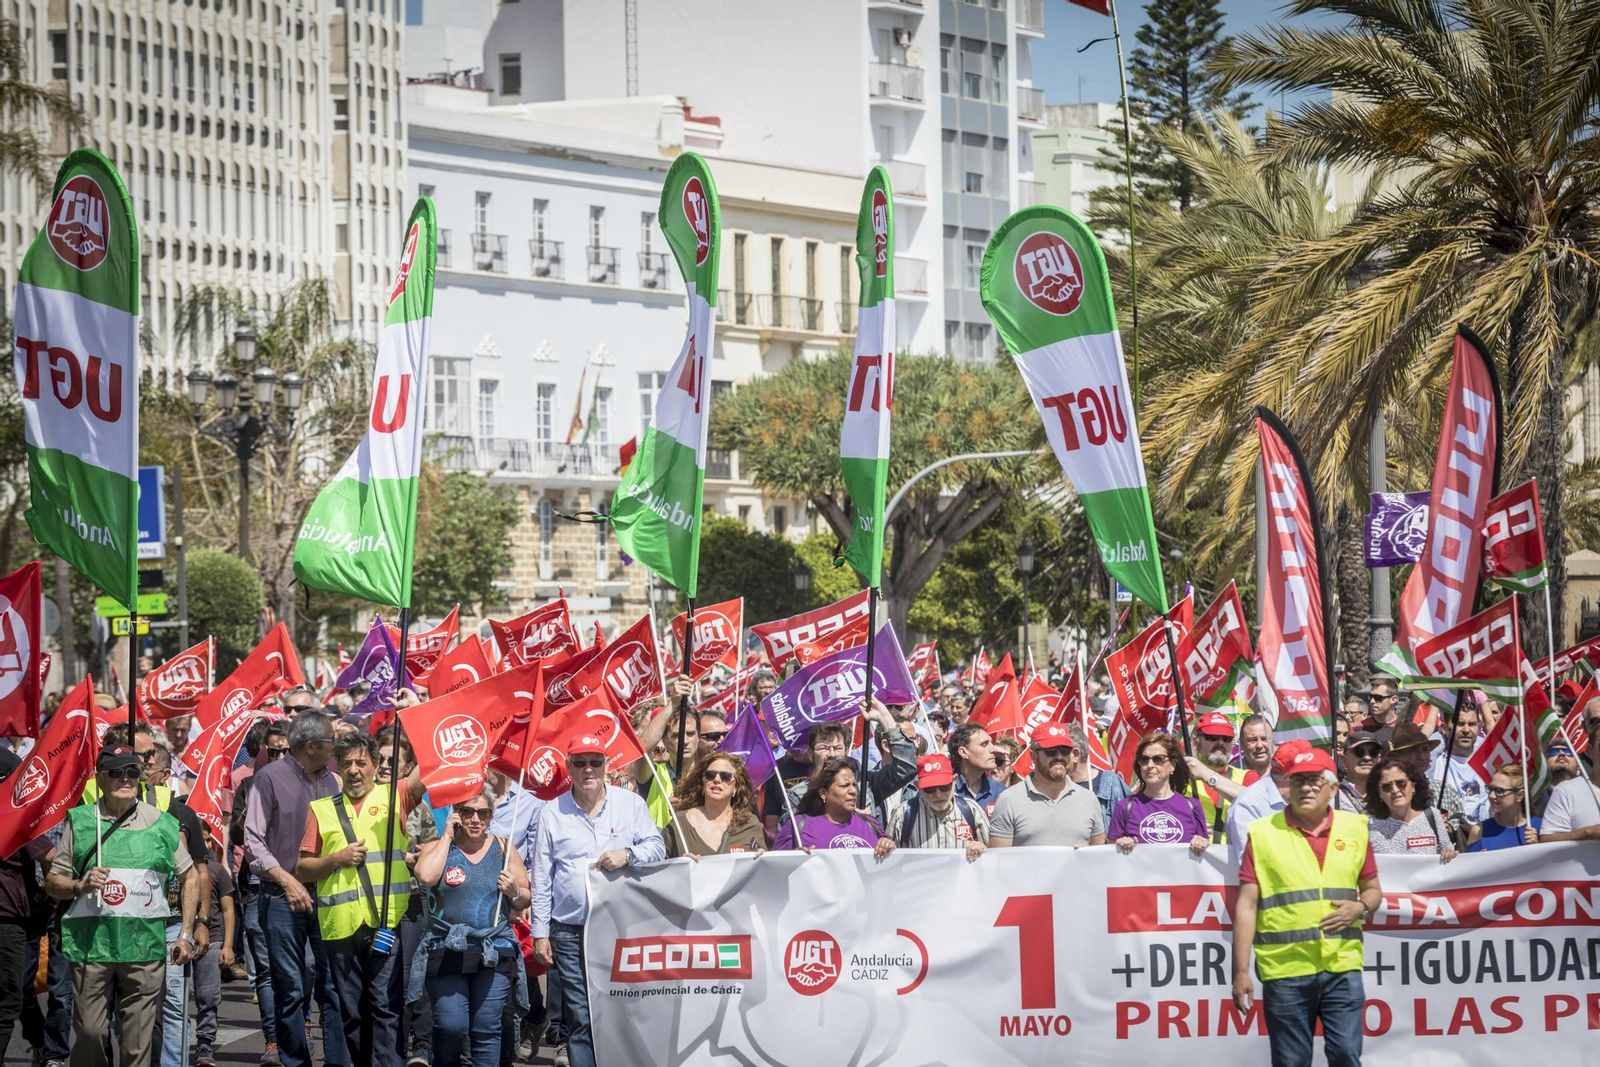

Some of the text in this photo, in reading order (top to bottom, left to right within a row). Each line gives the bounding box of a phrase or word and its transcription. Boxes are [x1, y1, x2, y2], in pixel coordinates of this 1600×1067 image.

[157, 659, 204, 691] UGT
[607, 647, 651, 701] UGT
[224, 690, 251, 716] UGT
[438, 720, 477, 750] UGT
[530, 749, 557, 784] UGT
[1142, 827, 1182, 835] FEMINISTA
[104, 884, 124, 895] UGT
[1156, 891, 1233, 925] LA
[618, 943, 717, 972] CCOO
[790, 940, 836, 968] UGT
[850, 953, 913, 967] Andalucía
[993, 894, 1056, 1010] 1
[851, 966, 889, 981] CÁDIZ
[609, 985, 742, 999] unión provincial de Cádiz
[1000, 1014, 1072, 1037] MAYO
[1414, 995, 1524, 1036] LAS
